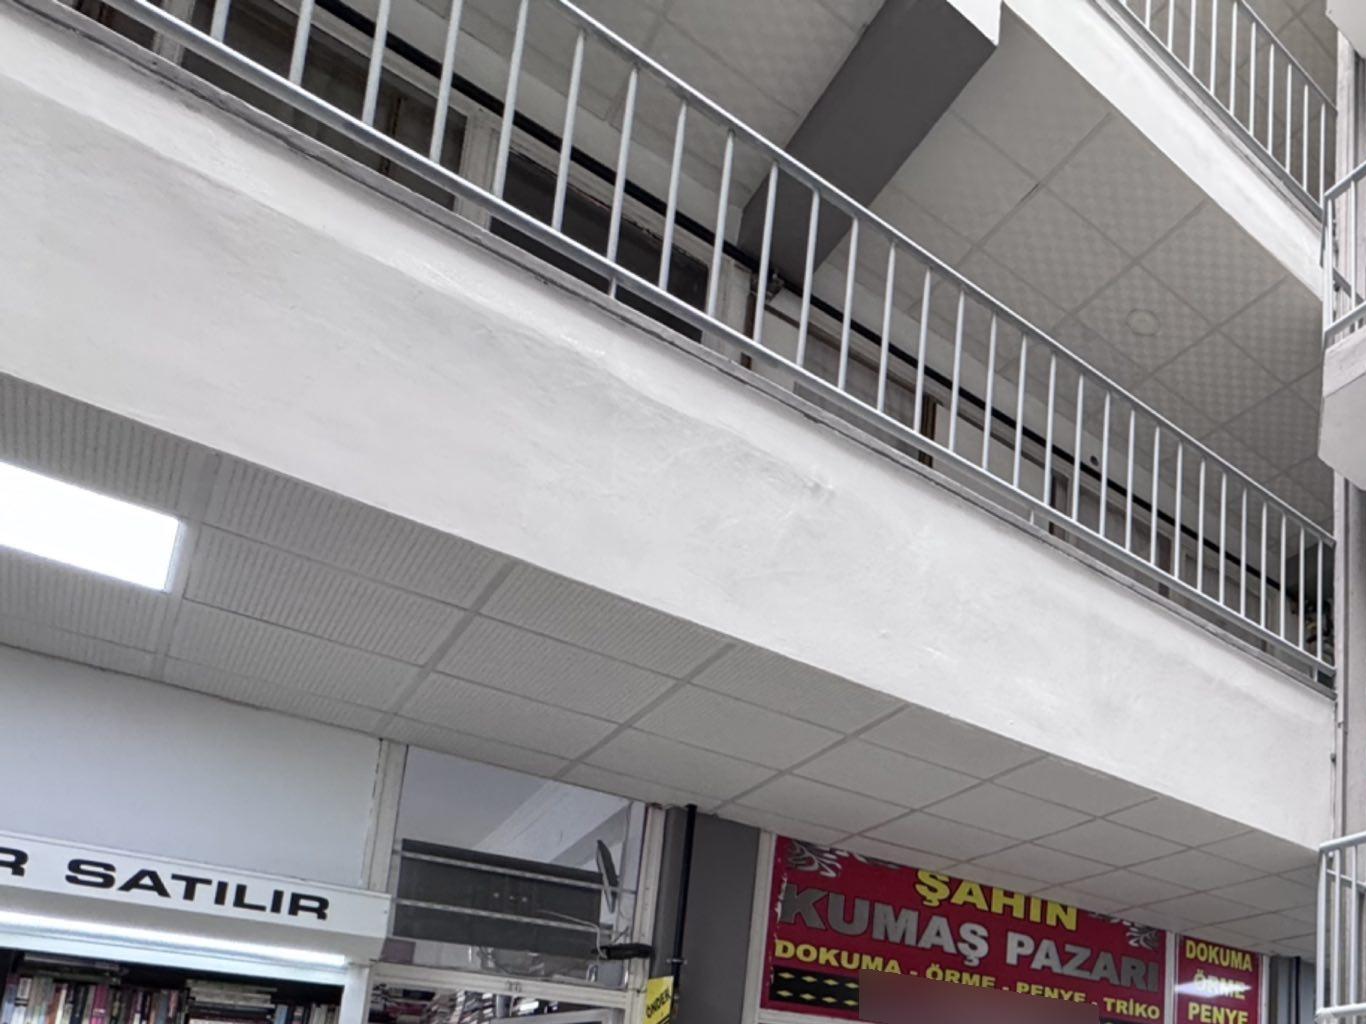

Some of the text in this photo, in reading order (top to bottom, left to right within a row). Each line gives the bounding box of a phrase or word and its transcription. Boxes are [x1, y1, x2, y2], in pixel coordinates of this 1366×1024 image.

[65, 858, 330, 920] SATILIR
[780, 883, 1159, 993] KUMAŞ PAZARI
[1185, 939, 1253, 972] DOKUMA
[775, 939, 902, 975] DOKUMA
[925, 963, 996, 988] ÖRME
[1103, 997, 1161, 1020] TRİKO
